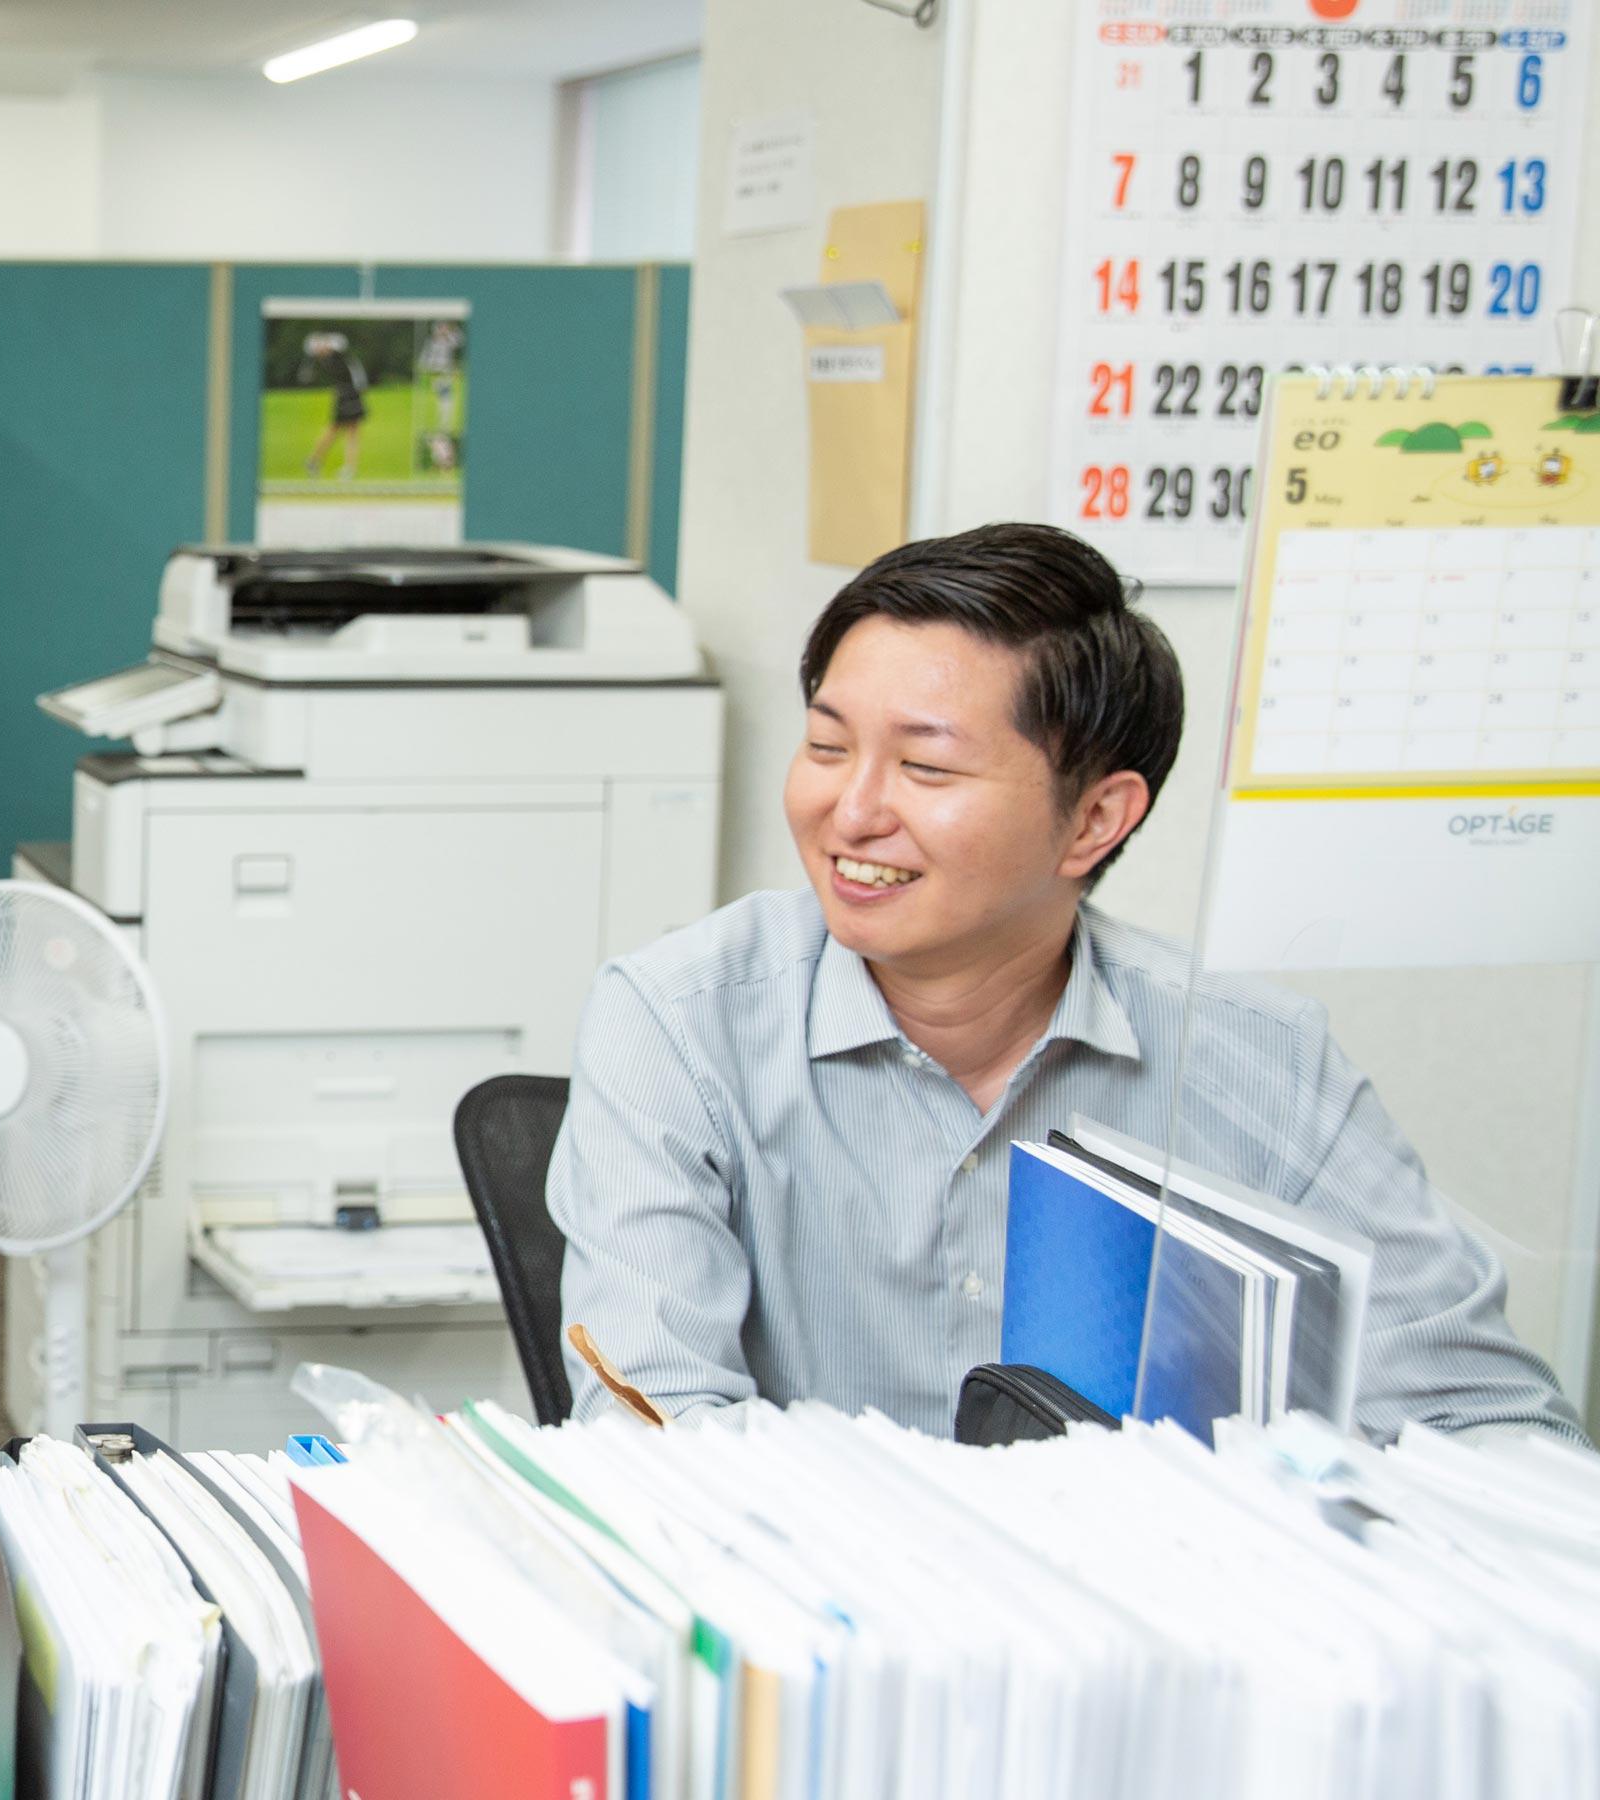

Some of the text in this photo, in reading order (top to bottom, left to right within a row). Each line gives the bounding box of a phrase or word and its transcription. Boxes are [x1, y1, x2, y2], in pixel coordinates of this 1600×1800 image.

[1117, 51, 1542, 108] 31 1 2 3 4 5 6
[1113, 154, 1547, 213] 7 8 9 10 11 12 13
[1096, 260, 1540, 316] 14 15 16 17 18 19 20
[1089, 363, 1262, 416] 21 22 23
[1292, 430, 1341, 451] eo
[1082, 467, 1129, 518] 28
[1147, 467, 1193, 518] 29
[1285, 468, 1308, 504] 5
[1447, 811, 1554, 836] OPTAGE
